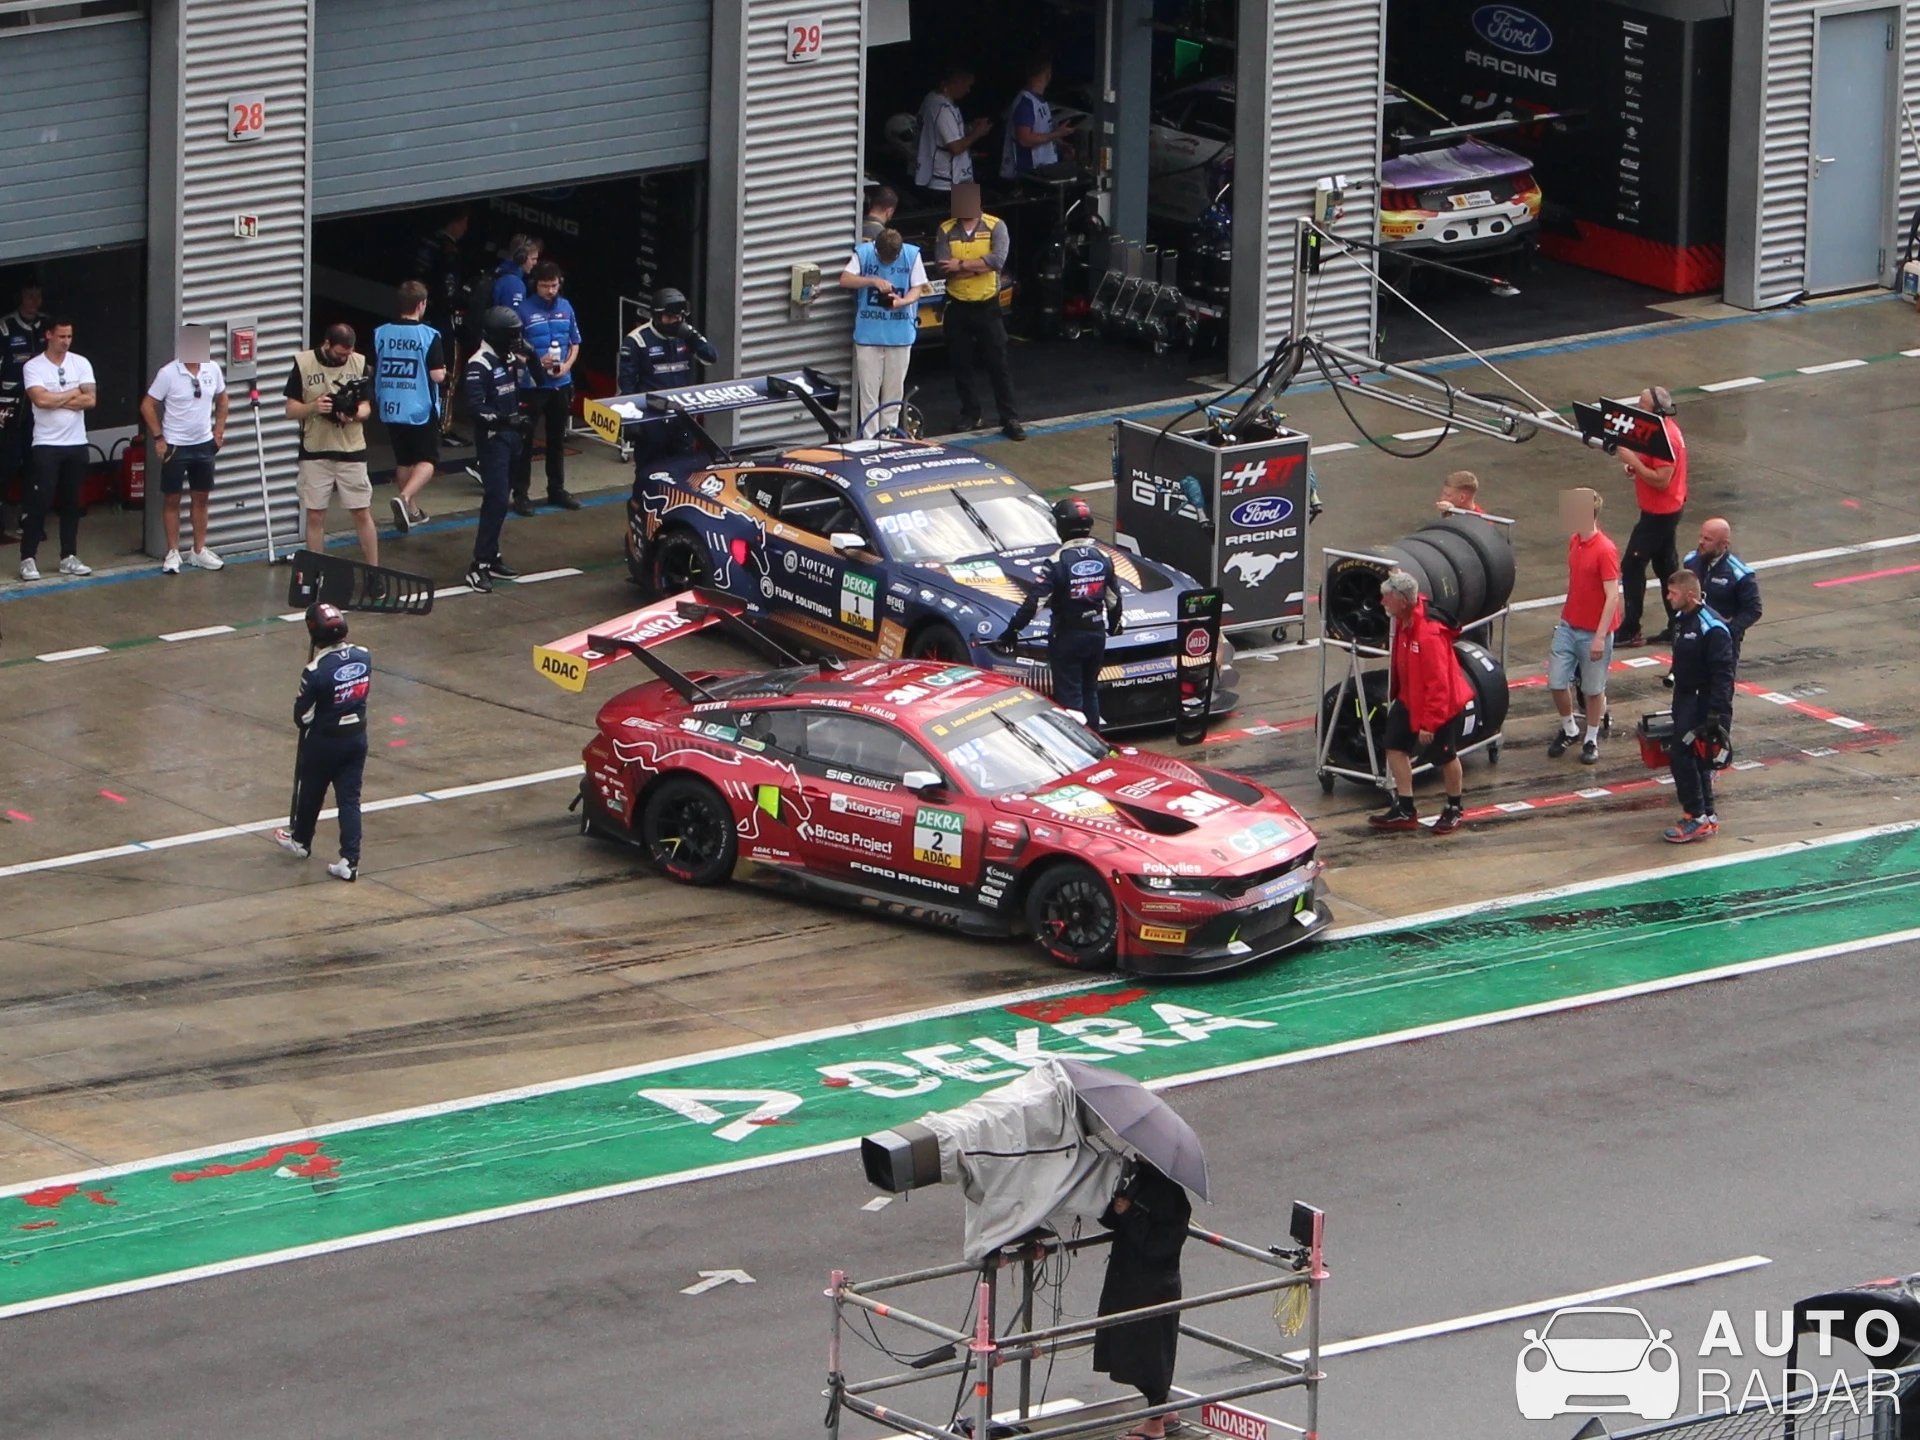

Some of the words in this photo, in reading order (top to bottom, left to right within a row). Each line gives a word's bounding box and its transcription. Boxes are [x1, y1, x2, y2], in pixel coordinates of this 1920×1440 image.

[793, 25, 820, 52] 29
[1488, 10, 1538, 49] Ford
[1465, 50, 1557, 87] RACING
[233, 103, 263, 132] 28
[860, 311, 888, 321] SOCIAL
[890, 311, 910, 320] MEDIA
[389, 338, 423, 352] DEKRA
[381, 360, 414, 375] DTM
[307, 373, 326, 386] 207
[395, 380, 417, 391] MEDIA
[667, 384, 758, 407] LEASHED
[590, 410, 616, 434] ADAC
[889, 463, 921, 473] FLOW
[922, 457, 980, 468] SOLUTIONS
[1242, 501, 1281, 523] Ford
[1225, 527, 1297, 547] RACING
[799, 556, 835, 579] NOVEM
[949, 560, 996, 570] DEKRA
[1337, 559, 1382, 573] PIRELLI
[808, 573, 823, 584] GOLD
[842, 573, 875, 598] DEKRA
[1070, 576, 1105, 585] RACING
[775, 586, 795, 602] FLOW
[795, 594, 833, 618] SOLUTIONS
[853, 596, 861, 614] 1
[847, 611, 869, 629] ADAC
[830, 631, 872, 652] RACING
[1189, 635, 1207, 649] STOP
[541, 656, 579, 680] ADAC
[1126, 660, 1171, 676] RAVENOL
[1112, 679, 1136, 688] HAUPT
[1137, 676, 1163, 686] RACING
[1164, 672, 1177, 680] TEA
[820, 698, 851, 708] K.BLUM
[884, 684, 930, 706] 3M
[861, 703, 897, 721] N.KALUS
[680, 717, 703, 731] 3M
[853, 775, 896, 792] CONNECT
[970, 762, 995, 789] 2
[833, 799, 901, 820] enterprise
[1166, 790, 1231, 818] 3M
[916, 810, 962, 832] DEKRA
[852, 833, 893, 855] Project
[931, 831, 944, 851] 2
[752, 846, 771, 855] ADAC
[772, 848, 790, 857] Team
[922, 850, 953, 866] ADAC
[850, 861, 895, 879] FORD
[898, 872, 960, 894] RACING
[1142, 862, 1202, 876] Polyvlies
[1265, 877, 1298, 897] RAVENOL
[1144, 928, 1183, 940] PIRELLI
[816, 1002, 1278, 1097] DEKRA
[1209, 1406, 1266, 1440] XERVON
